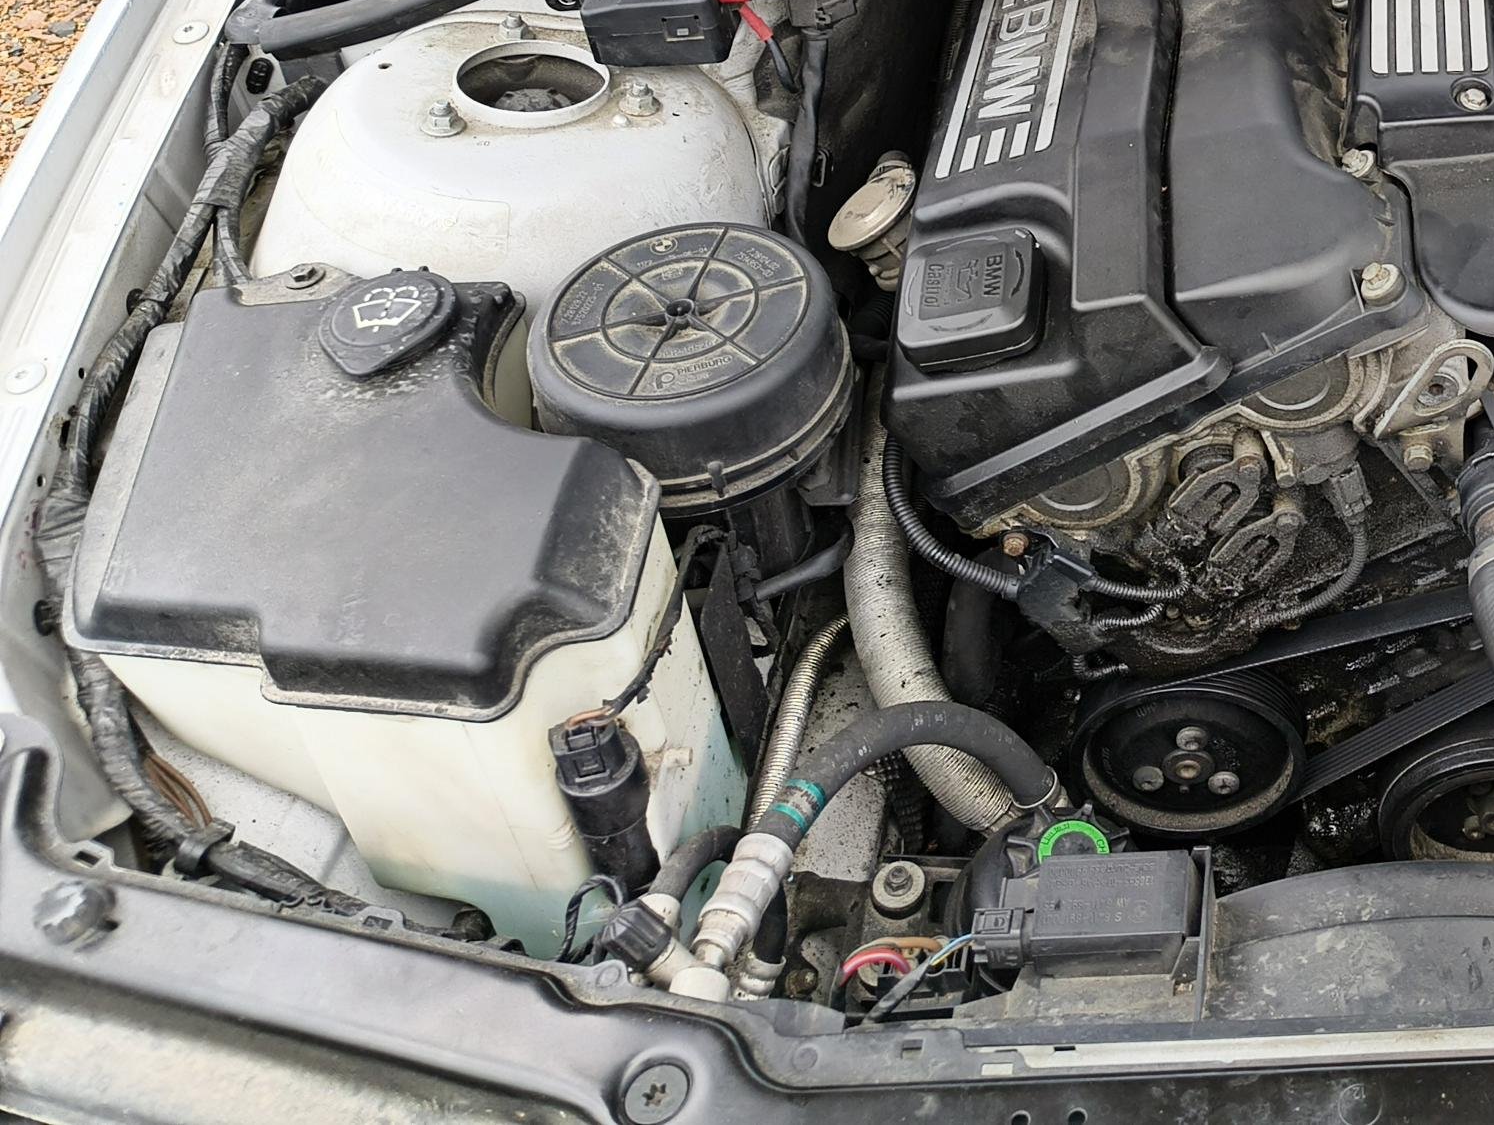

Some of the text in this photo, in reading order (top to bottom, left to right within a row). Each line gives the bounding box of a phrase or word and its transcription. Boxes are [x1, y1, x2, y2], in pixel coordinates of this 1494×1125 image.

[923, 263, 945, 308] Castrol
[983, 254, 1003, 296] BMW
[676, 354, 734, 376] PIERBURG
